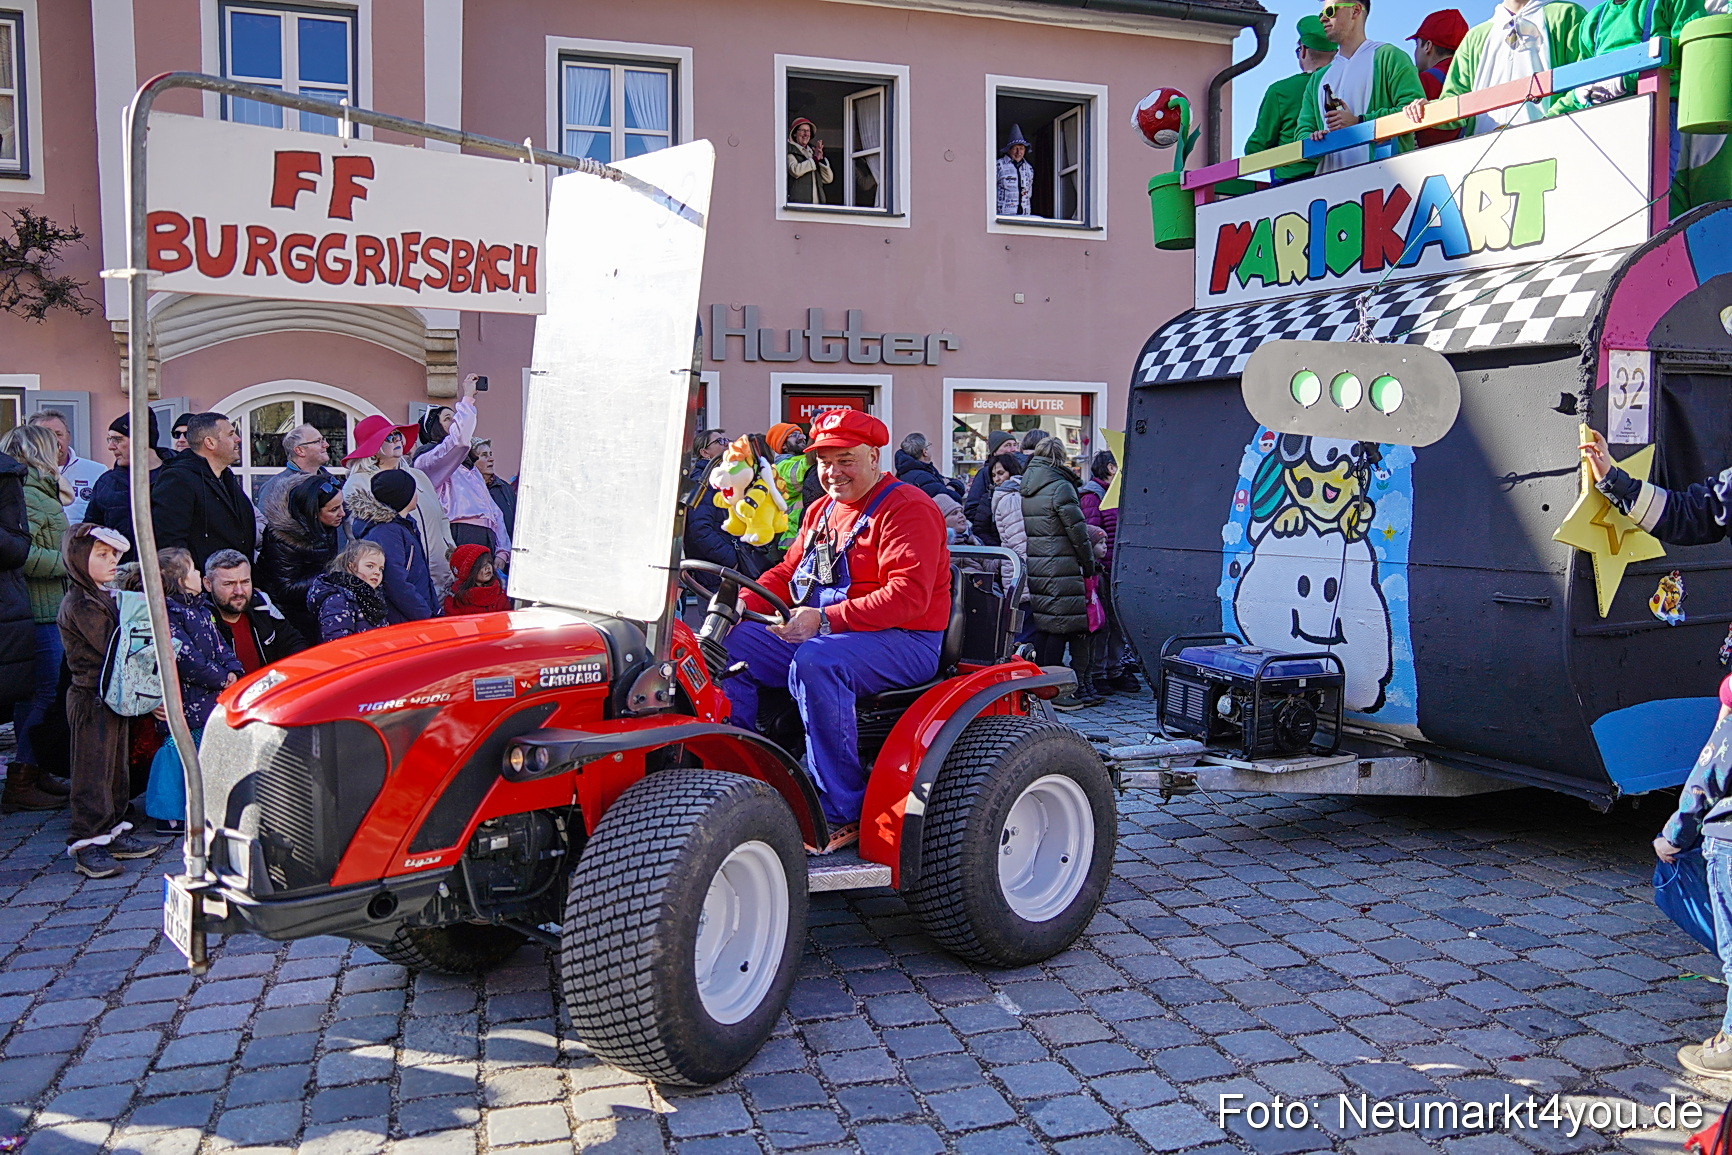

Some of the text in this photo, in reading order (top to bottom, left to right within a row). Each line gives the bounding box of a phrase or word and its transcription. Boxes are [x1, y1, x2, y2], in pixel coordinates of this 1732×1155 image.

[270, 150, 375, 221] FF
[146, 210, 539, 295] BURGGRIESBACH
[711, 303, 960, 366] Hutter
[1021, 398, 1065, 411] HUTTER
[1612, 366, 1646, 411] 32
[826, 416, 839, 427] M
[539, 662, 602, 676] ANTONIO
[357, 692, 451, 713] TIGRE 4000
